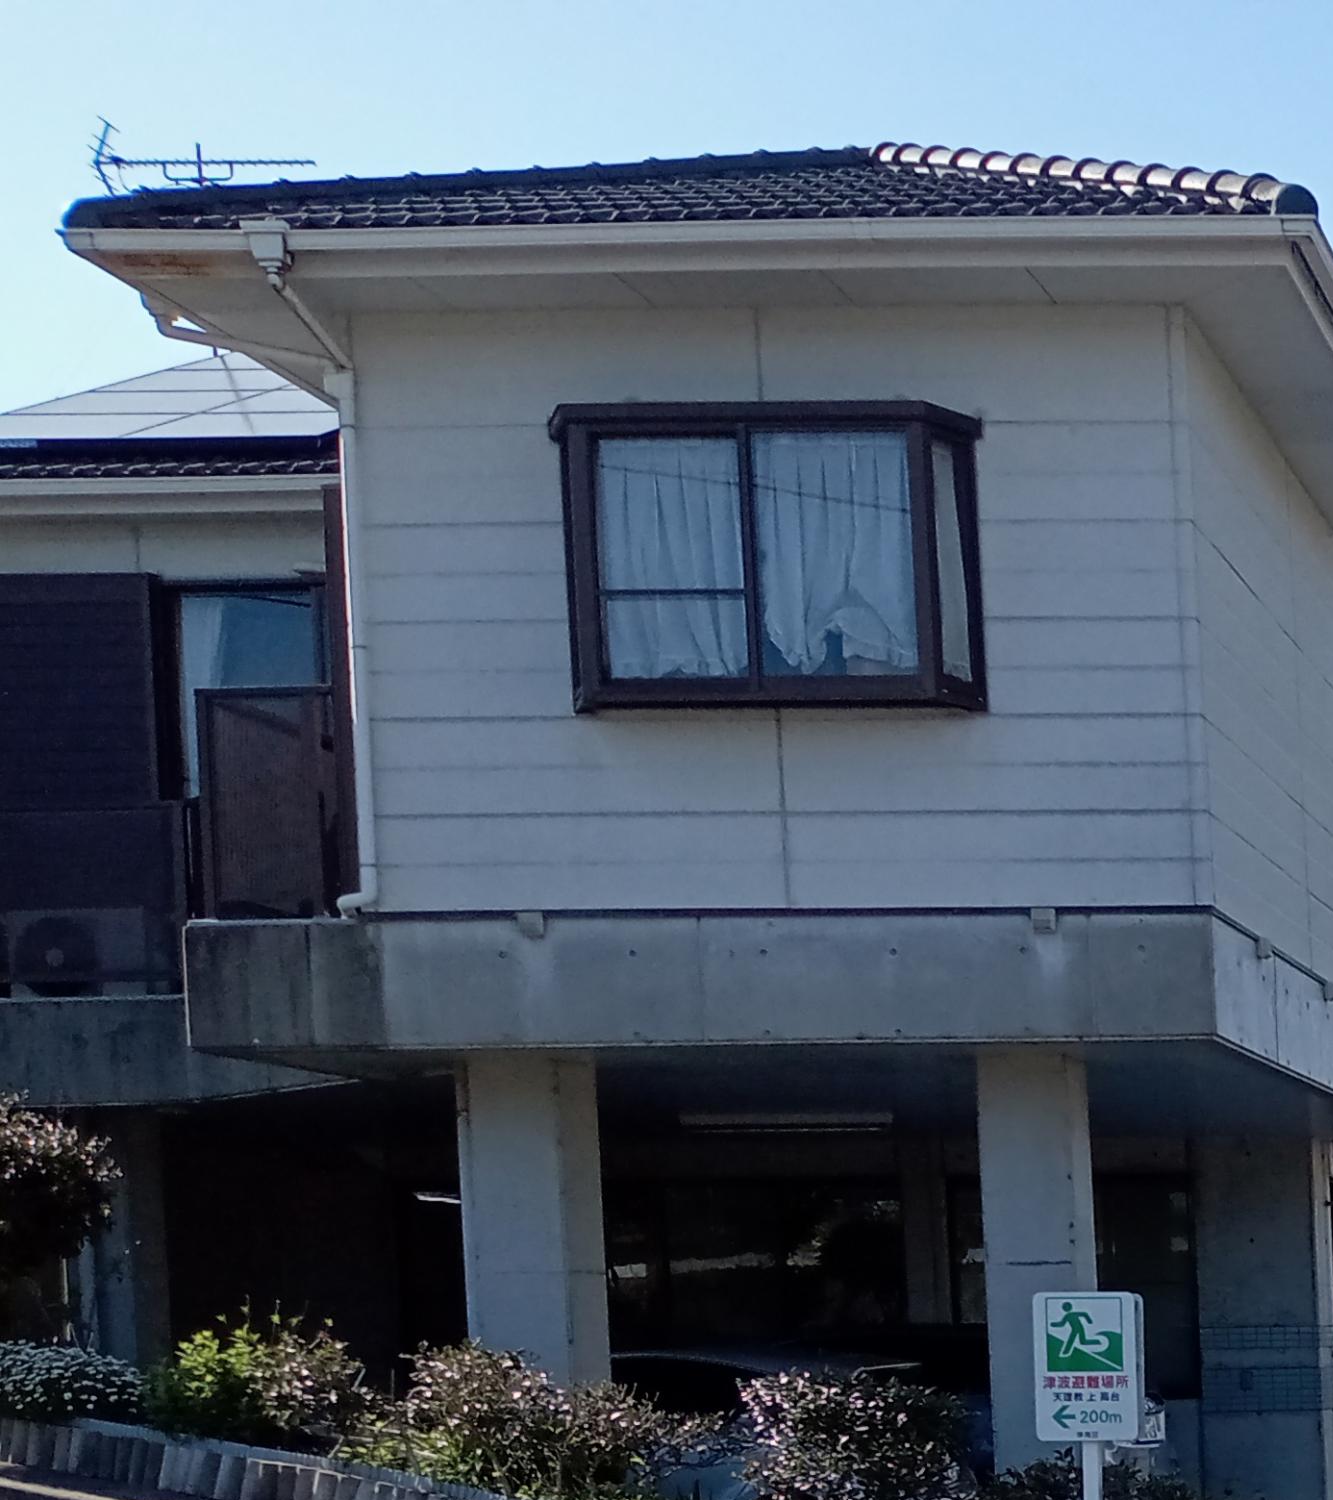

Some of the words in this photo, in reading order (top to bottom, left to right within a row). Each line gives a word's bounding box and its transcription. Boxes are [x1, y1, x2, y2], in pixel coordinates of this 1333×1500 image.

[1042, 1375, 1129, 1389] 津波避難場所
[1079, 1410, 1123, 1424] 200m
